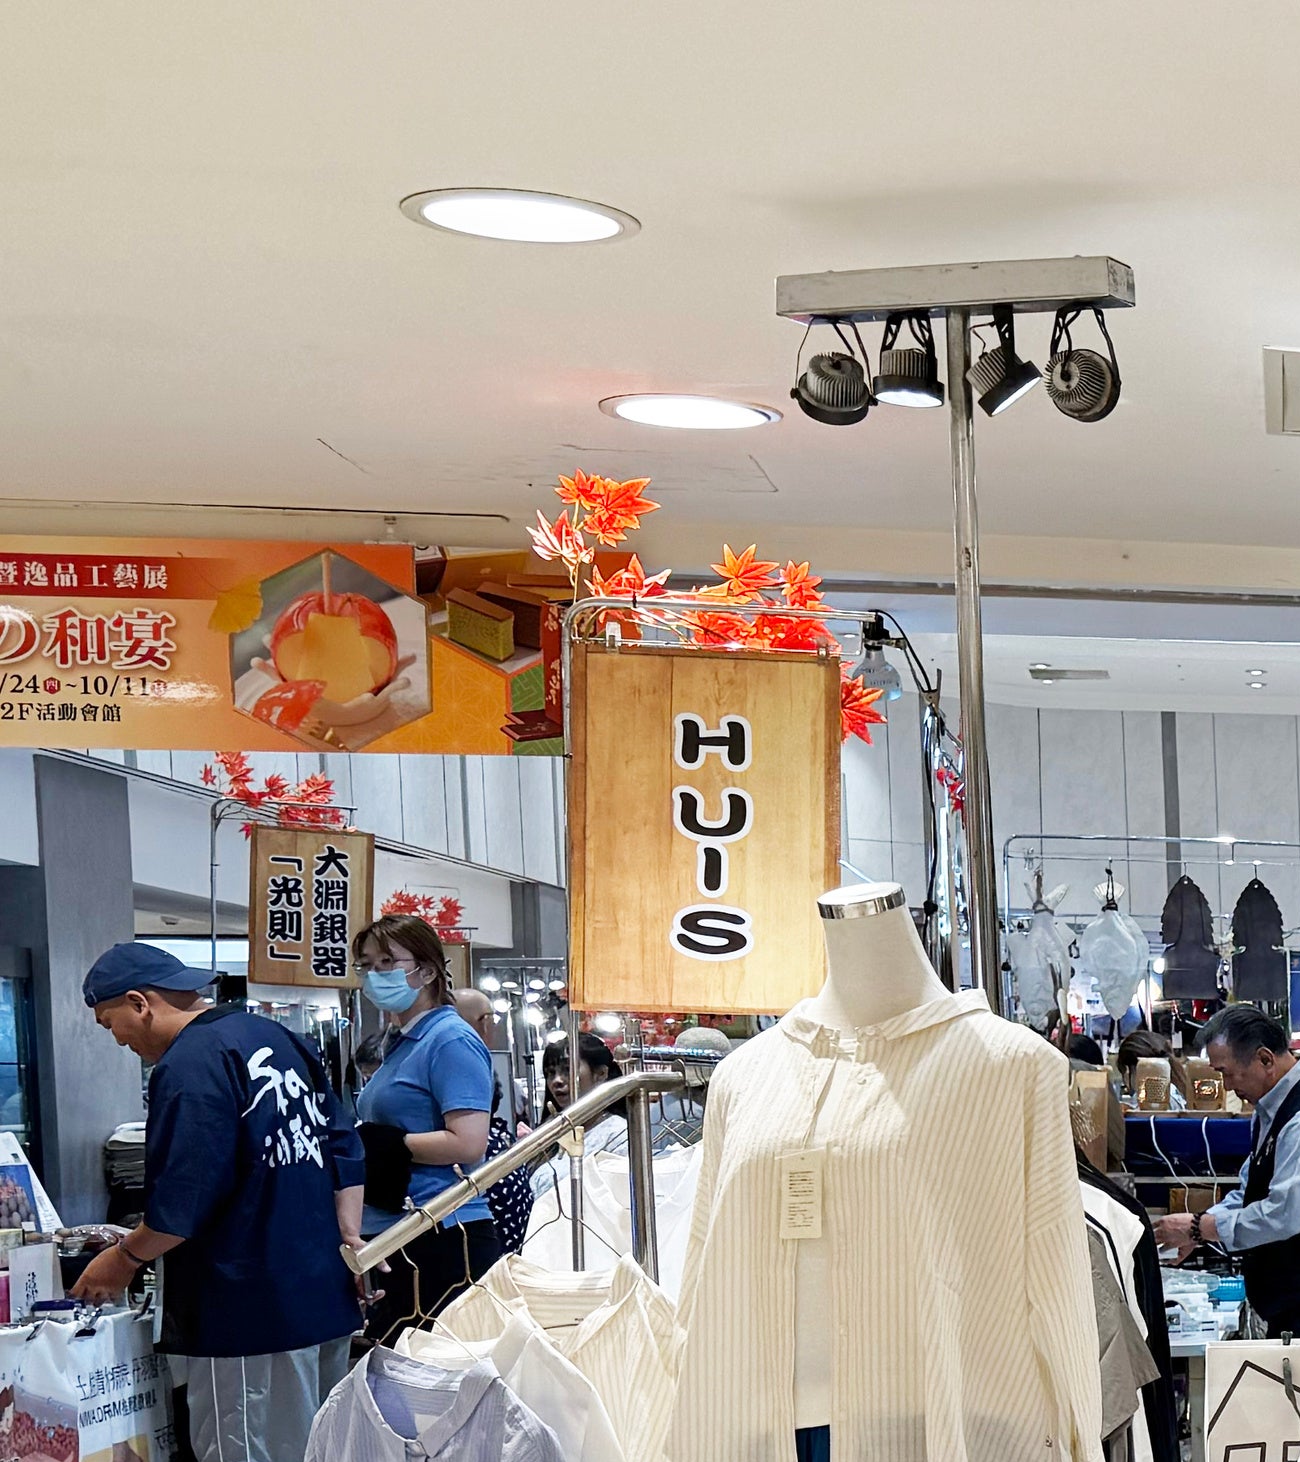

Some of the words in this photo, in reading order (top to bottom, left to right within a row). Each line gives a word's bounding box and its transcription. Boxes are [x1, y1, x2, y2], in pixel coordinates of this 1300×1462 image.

[312, 845, 349, 977] 大淵銀器
[672, 713, 753, 960] HUIS
